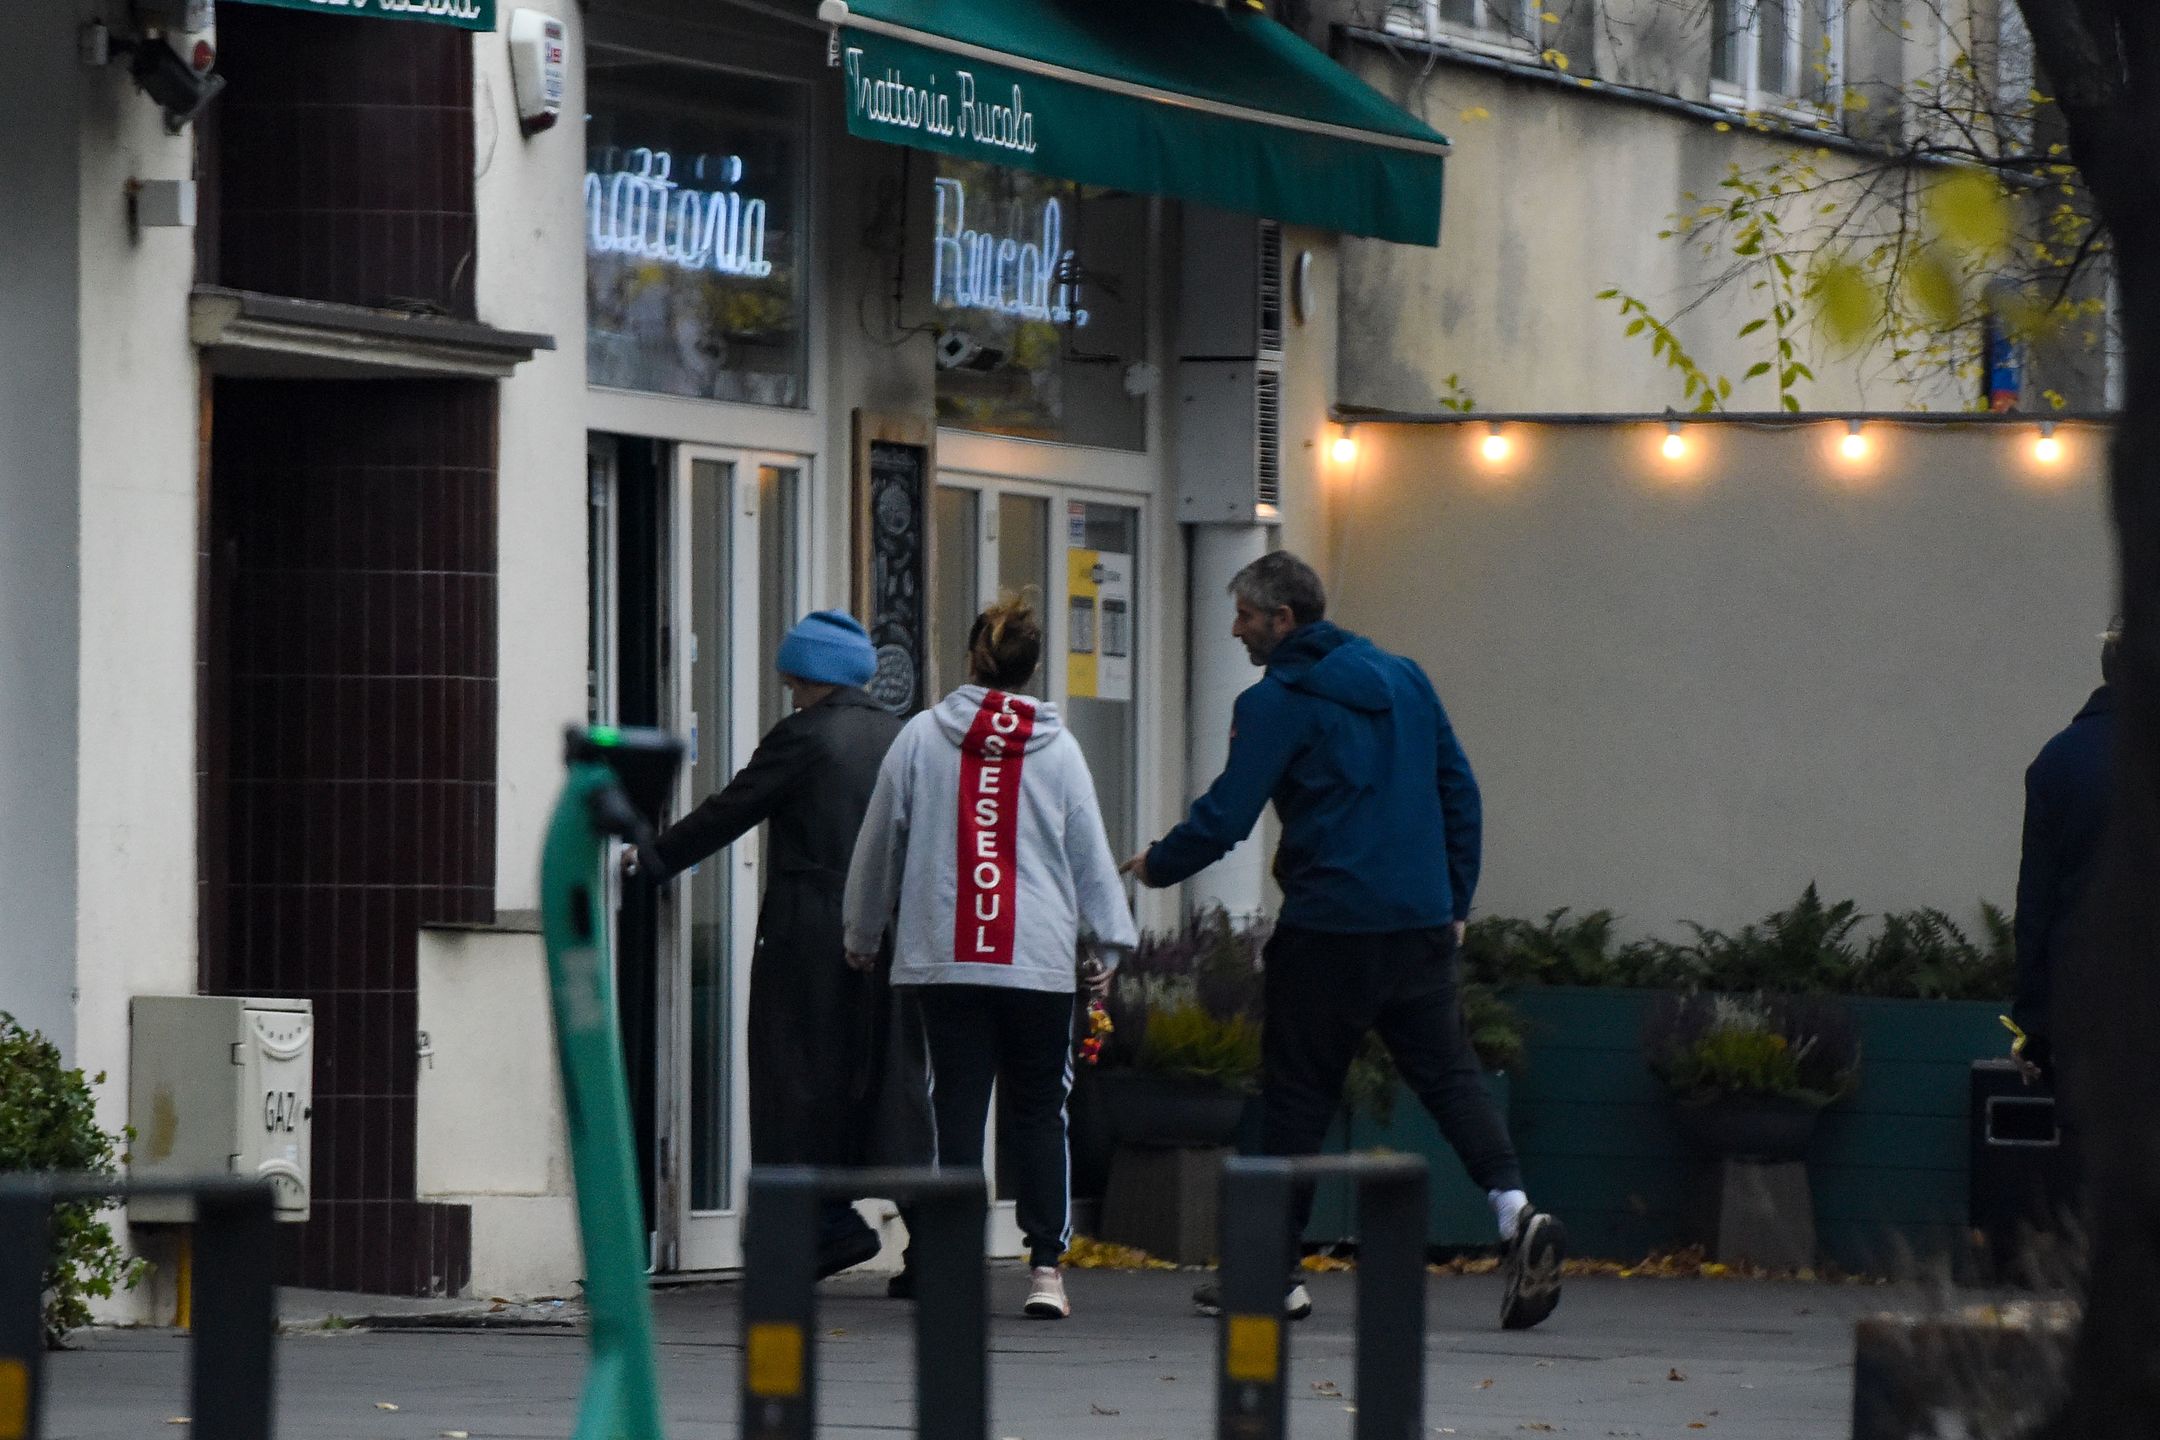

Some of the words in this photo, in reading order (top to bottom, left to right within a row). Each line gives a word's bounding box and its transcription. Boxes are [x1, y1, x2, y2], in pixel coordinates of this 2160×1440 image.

[846, 47, 954, 136] Trattoria
[957, 70, 1036, 153] Rucola
[265, 1091, 296, 1133] GAZ
